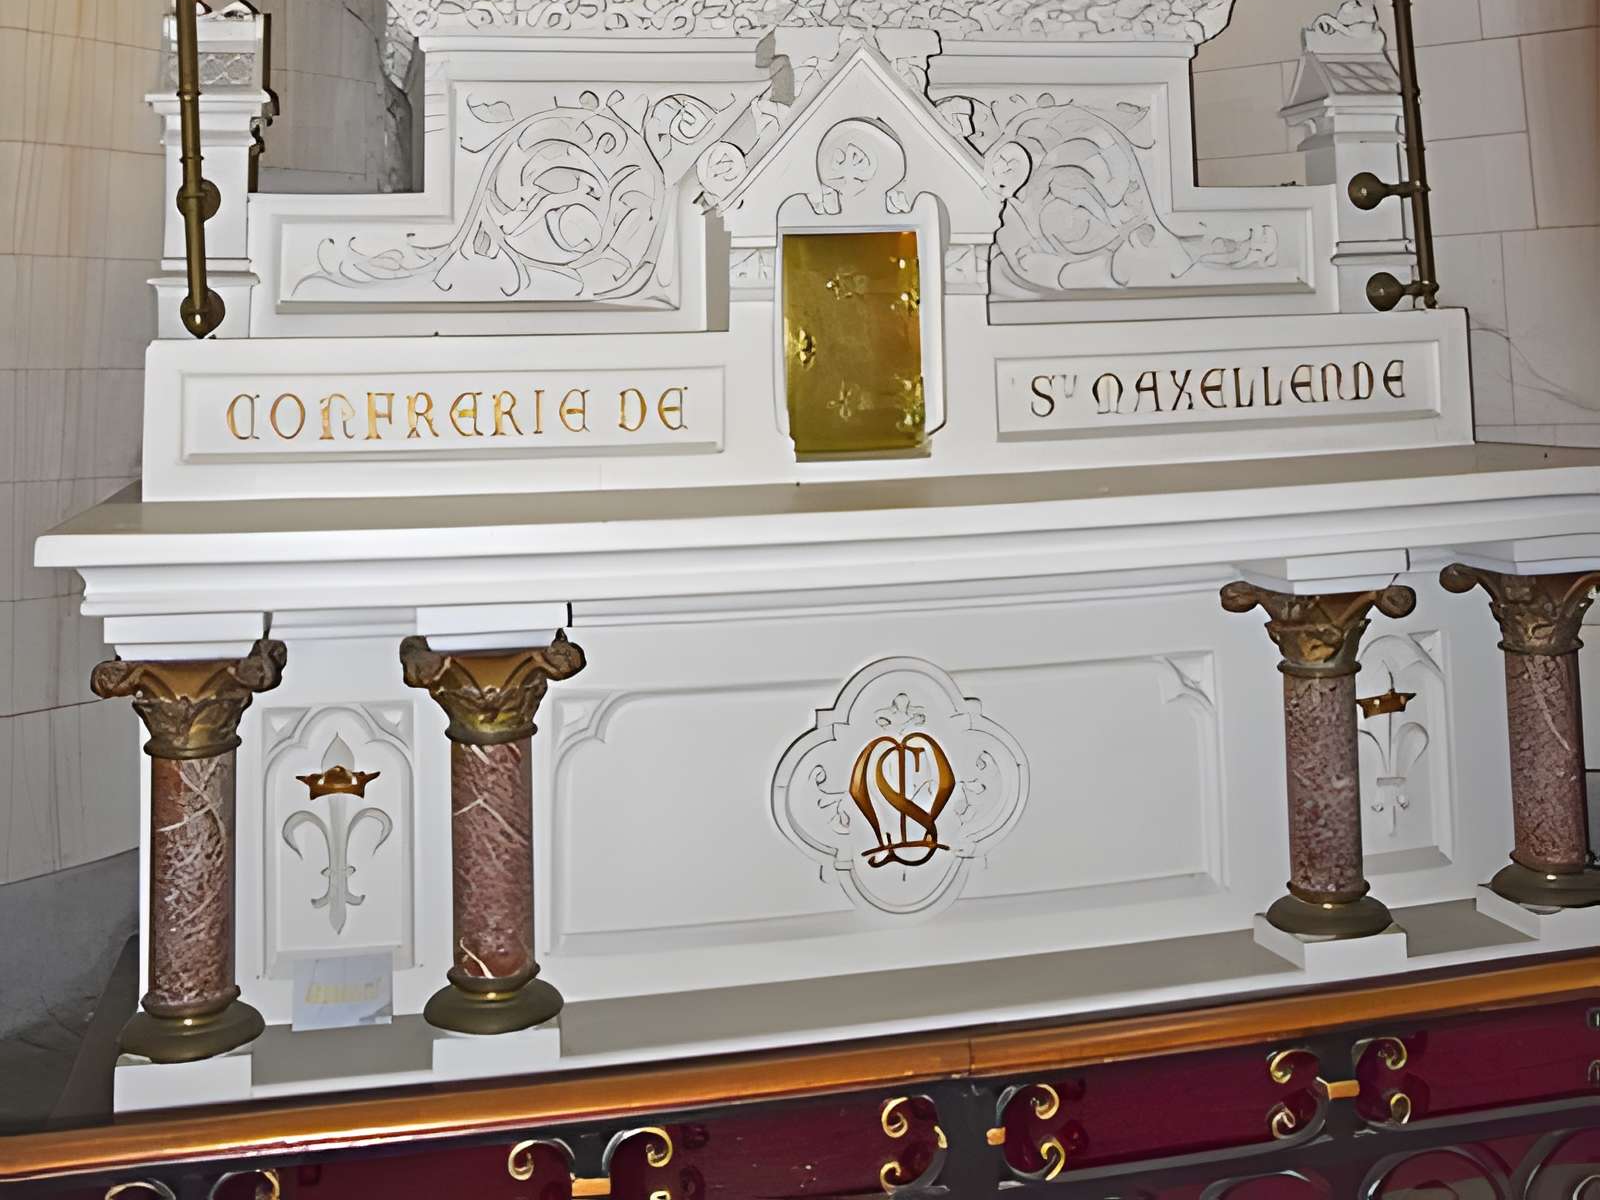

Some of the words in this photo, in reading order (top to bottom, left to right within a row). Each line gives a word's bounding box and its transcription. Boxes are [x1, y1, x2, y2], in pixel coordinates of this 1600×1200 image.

[226, 388, 591, 441] CONFRERIE
[618, 386, 689, 432] DE
[1092, 359, 1406, 415] MAXELLENDE
